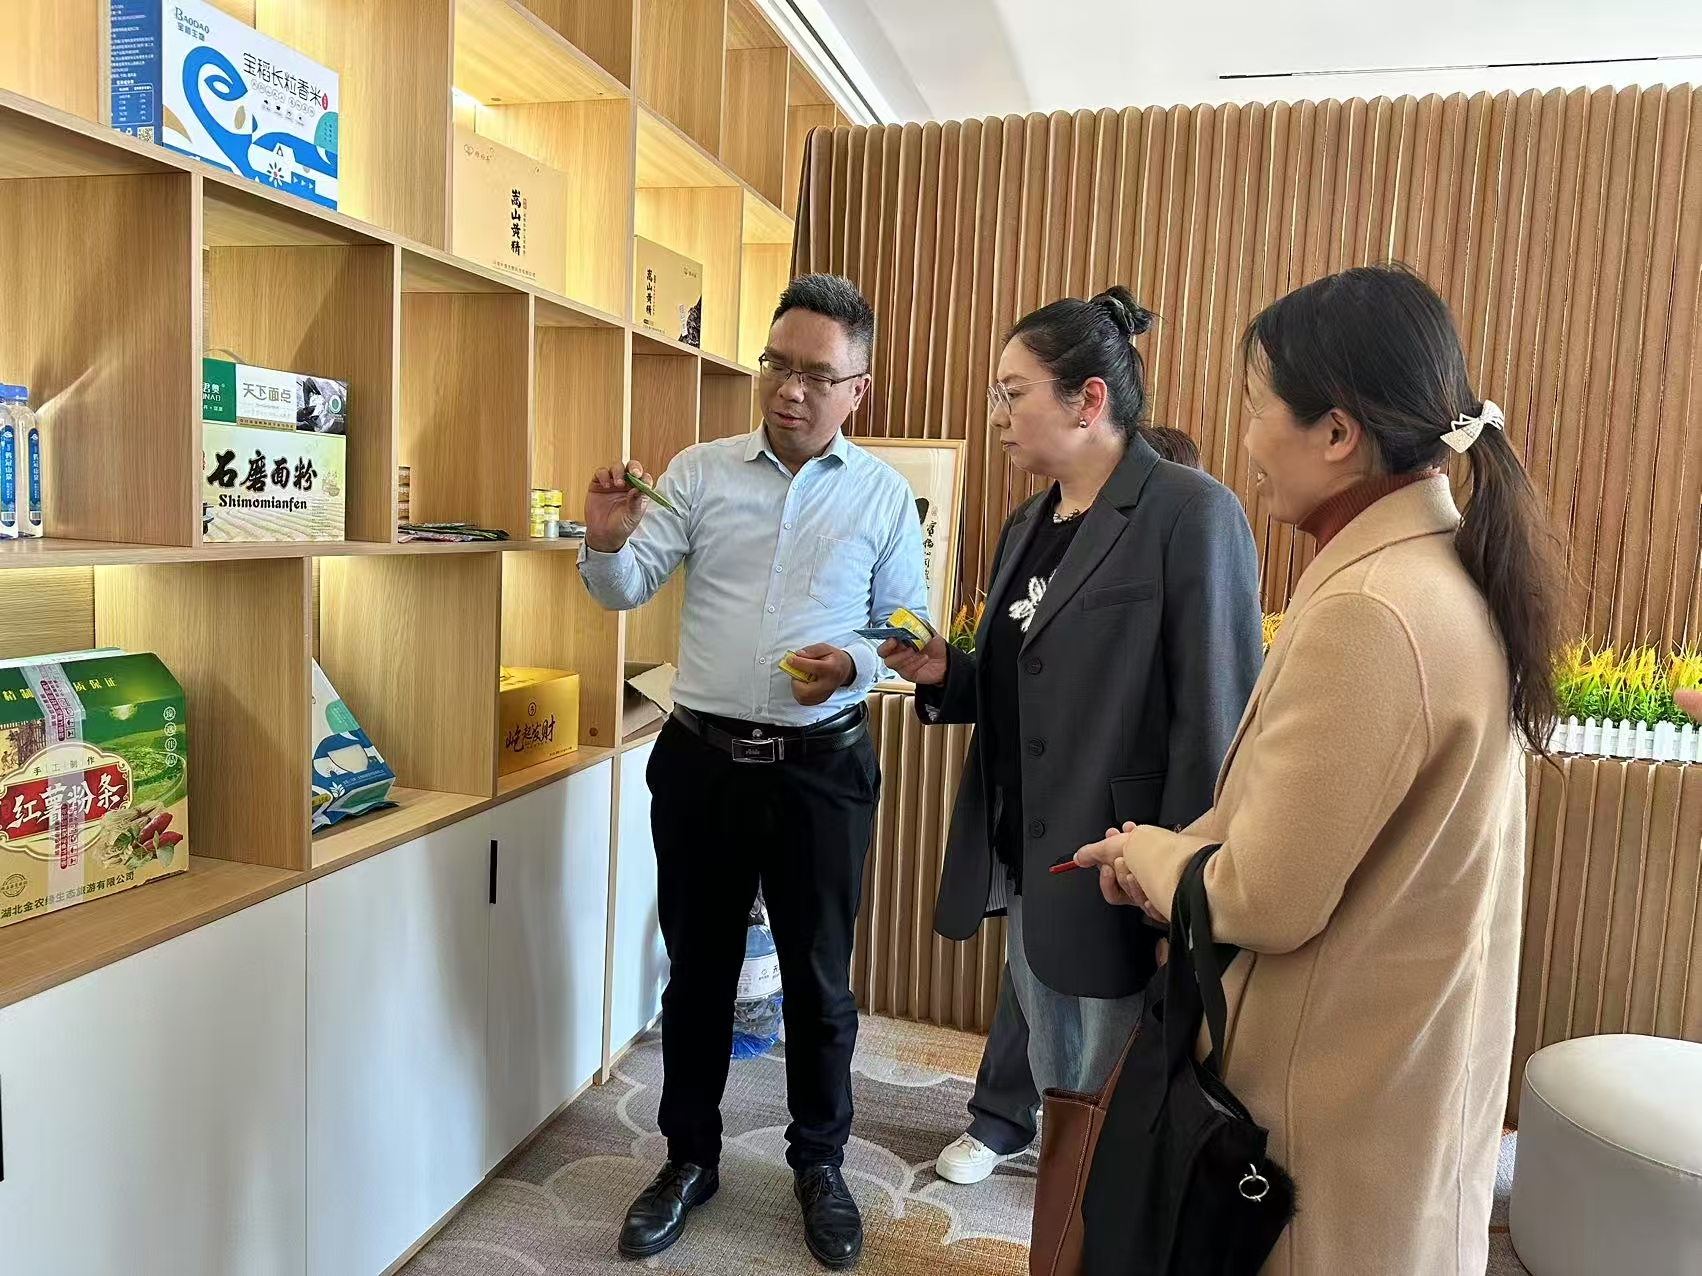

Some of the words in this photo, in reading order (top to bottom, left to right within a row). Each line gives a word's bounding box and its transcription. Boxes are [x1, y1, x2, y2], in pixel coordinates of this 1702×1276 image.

[243, 52, 322, 107] 宝稻长粒香米
[242, 382, 292, 404] 天下面点
[207, 449, 318, 492] 石磨面粉
[218, 494, 307, 512] Shimomianfen
[5, 773, 125, 830] 红薯粉条
